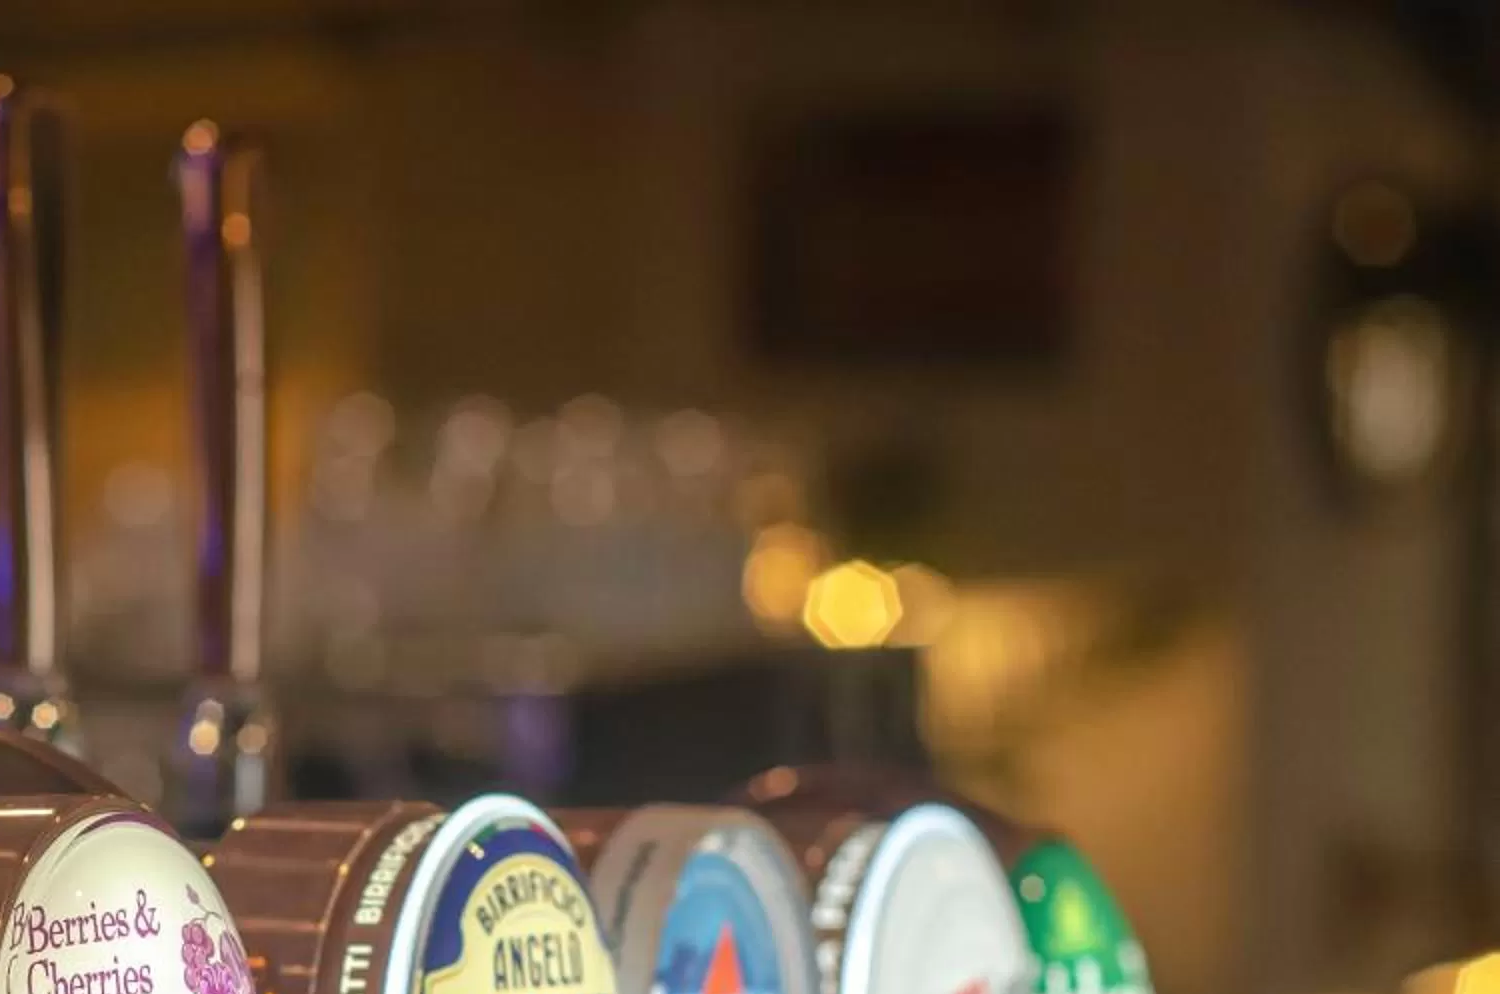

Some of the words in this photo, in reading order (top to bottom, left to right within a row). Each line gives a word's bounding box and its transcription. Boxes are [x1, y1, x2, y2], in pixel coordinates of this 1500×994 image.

[26, 900, 130, 955] Berries
[134, 888, 162, 939] &
[493, 930, 584, 993] ANGELO
